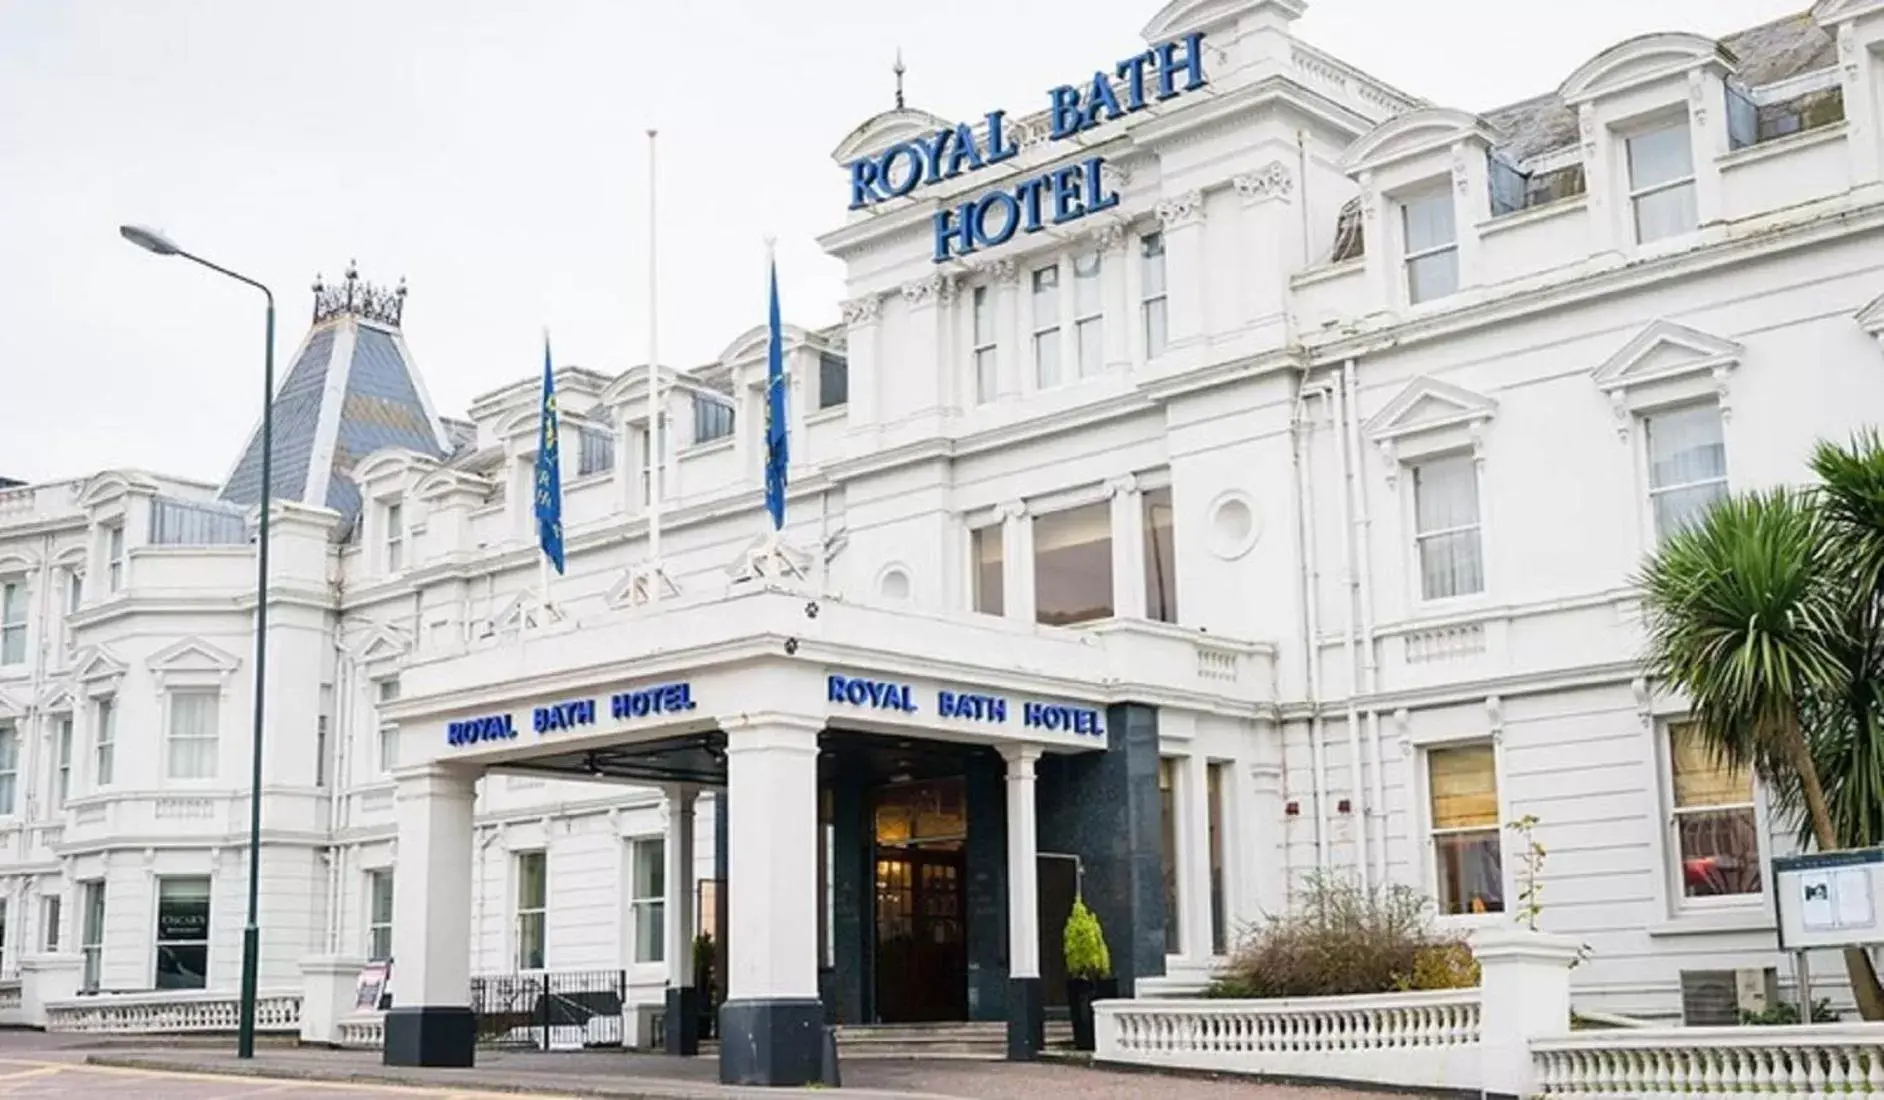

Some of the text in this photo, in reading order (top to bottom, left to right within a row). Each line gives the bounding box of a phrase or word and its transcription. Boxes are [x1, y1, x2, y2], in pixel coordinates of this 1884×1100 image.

[847, 31, 1206, 210] ROYAL BATH
[932, 156, 1120, 263] HOTEL
[447, 682, 697, 747] ROYAL BATH HOTEL
[827, 674, 1105, 736] ROYAL BATH HOTEL
